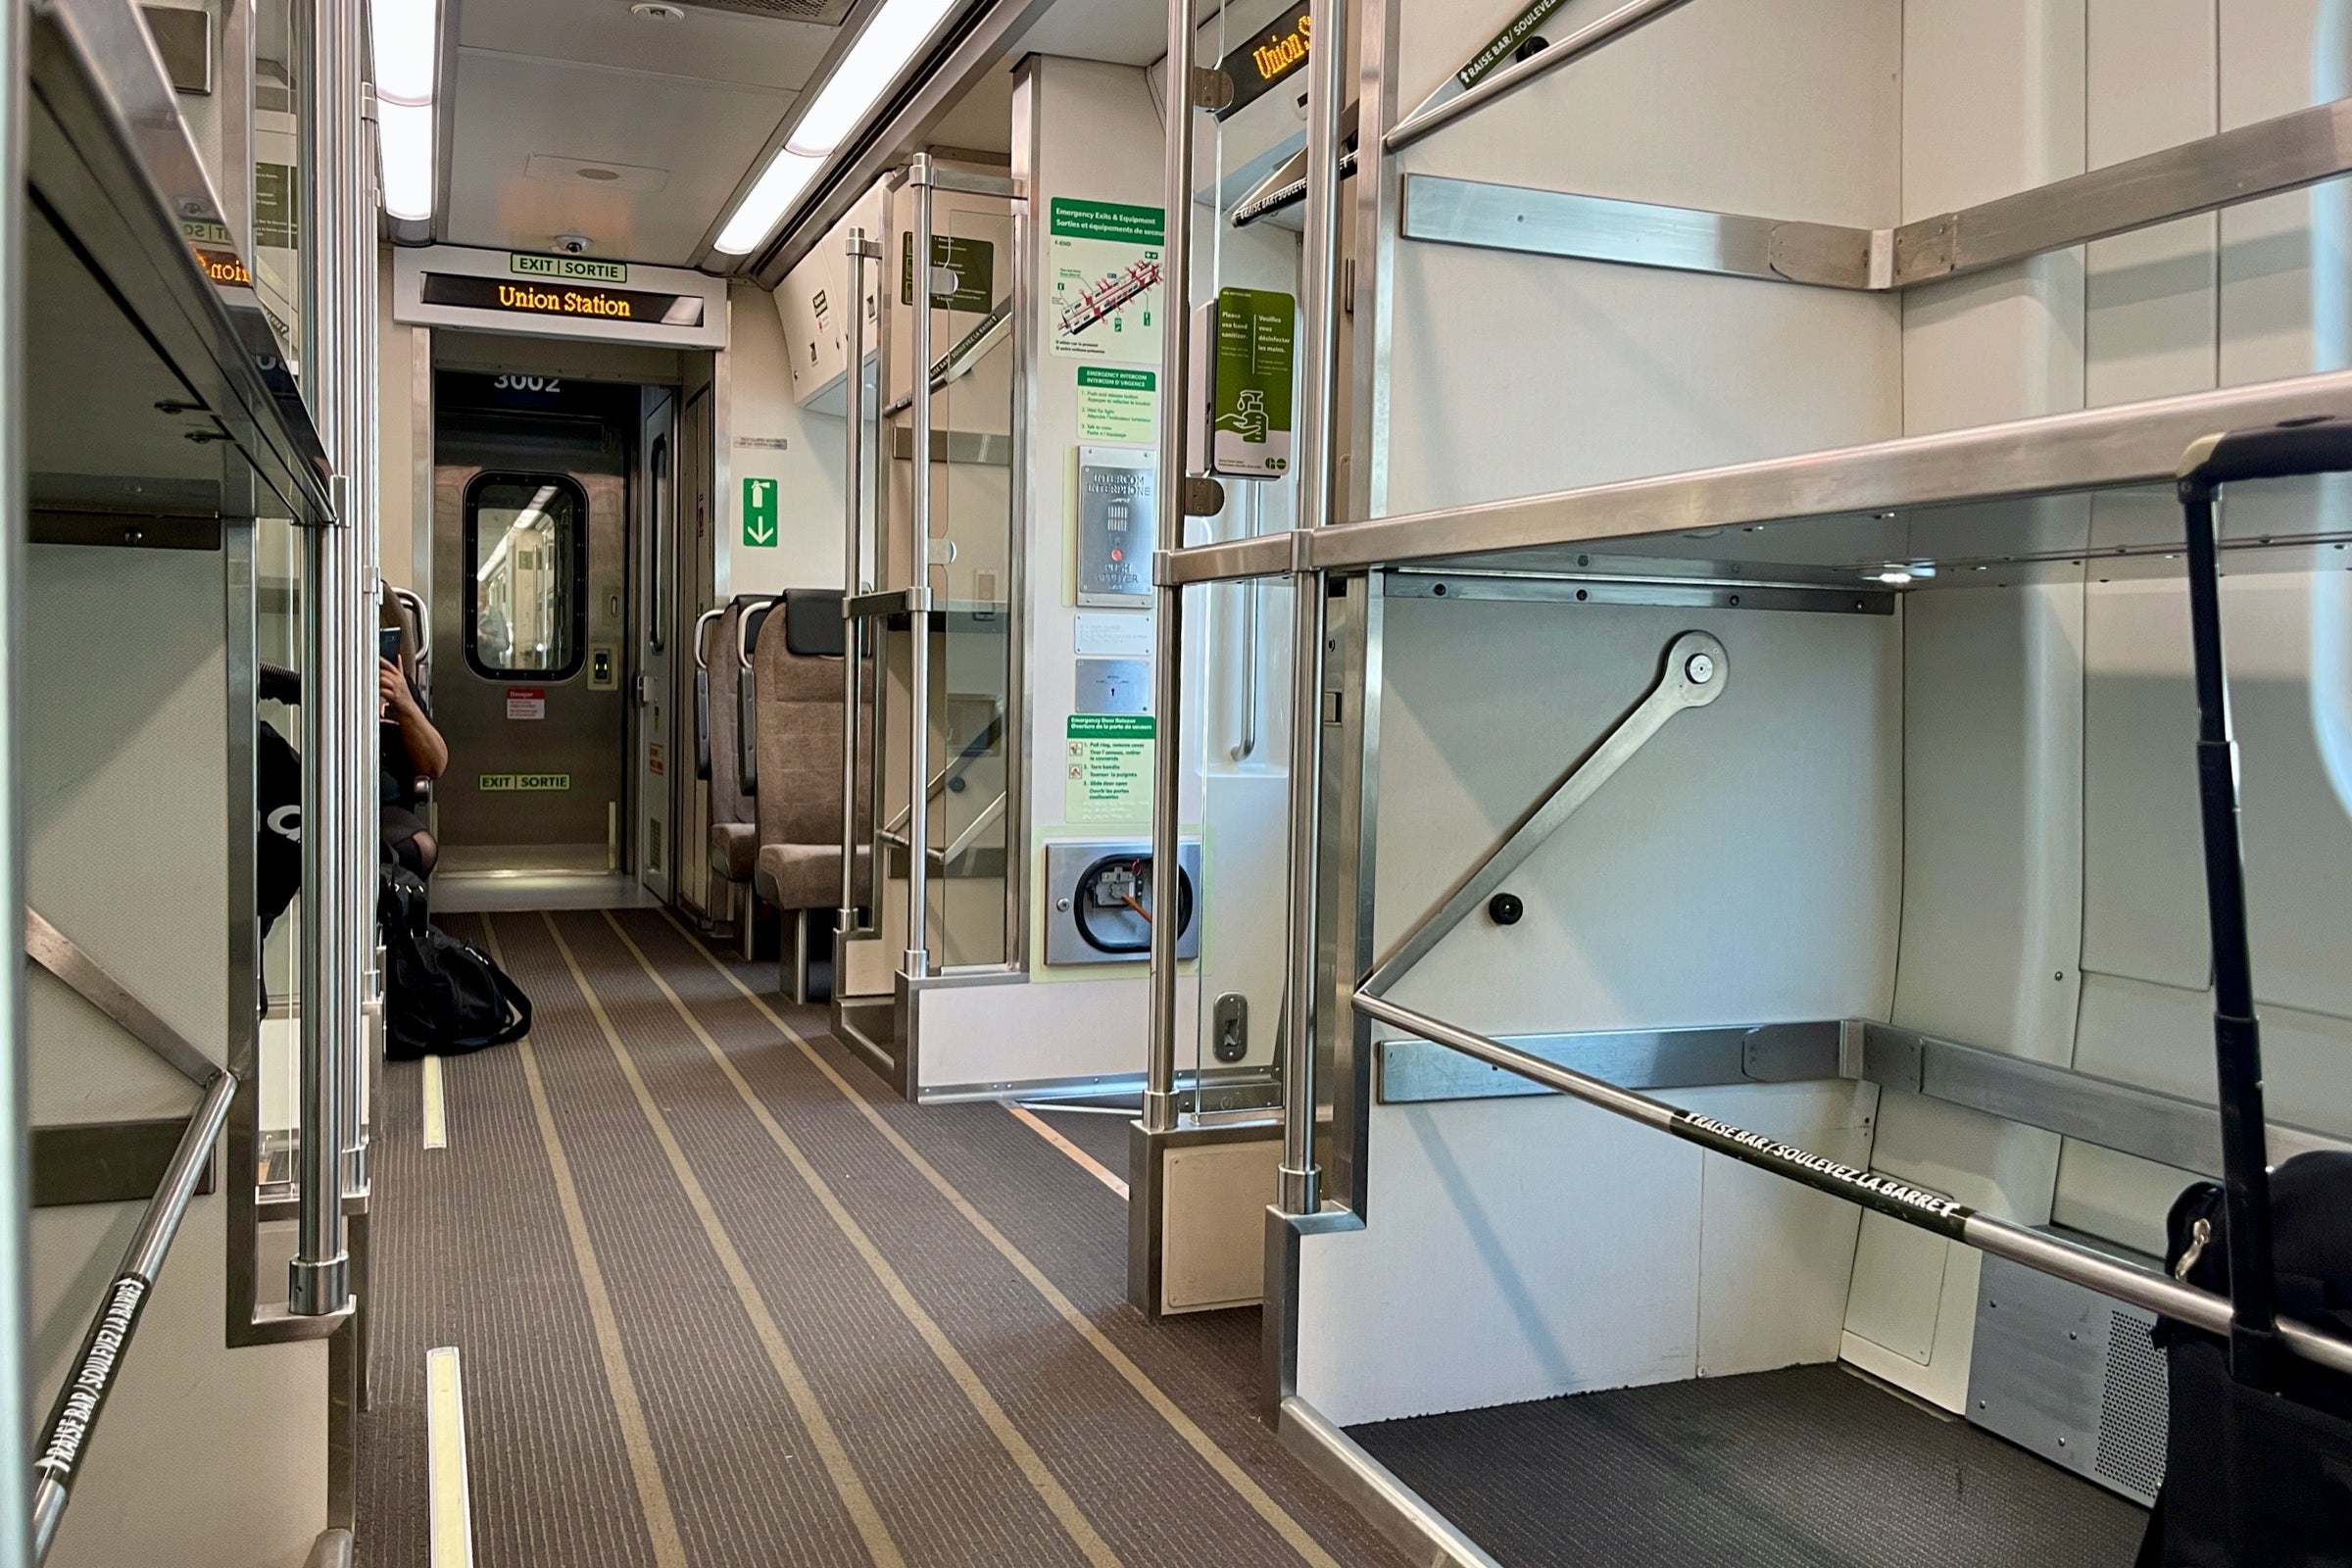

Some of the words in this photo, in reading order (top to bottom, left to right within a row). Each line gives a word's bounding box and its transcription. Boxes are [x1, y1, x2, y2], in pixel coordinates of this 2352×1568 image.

[1252, 34, 1304, 78] Union
[1468, 51, 1494, 77] RAISE
[1056, 208, 1094, 220] Emergency
[1120, 215, 1155, 224] Equipment
[1089, 223, 1133, 233] équipements
[520, 258, 553, 271] EXIT
[565, 263, 618, 277] SORTIE
[499, 286, 560, 311] Union
[564, 292, 630, 317] Station
[1258, 315, 1281, 323] Veuillez
[1087, 483, 1151, 496] INTERPHONE
[1094, 473, 1145, 486] INTERCOM
[482, 777, 511, 787] EXIT
[521, 777, 566, 787] SORTIE
[1694, 1115, 1739, 1138] RAISE
[1734, 1131, 1766, 1151] BAR
[1774, 1145, 1860, 1182] SOULEVEZ
[1856, 1174, 1882, 1191] LA
[1880, 1182, 1944, 1212] BARRE
[108, 1286, 143, 1321] BARRE
[102, 1317, 129, 1333] LA
[78, 1329, 122, 1390] SOULEVEZ
[63, 1392, 97, 1423] BAR
[46, 1419, 85, 1462] RAISE
